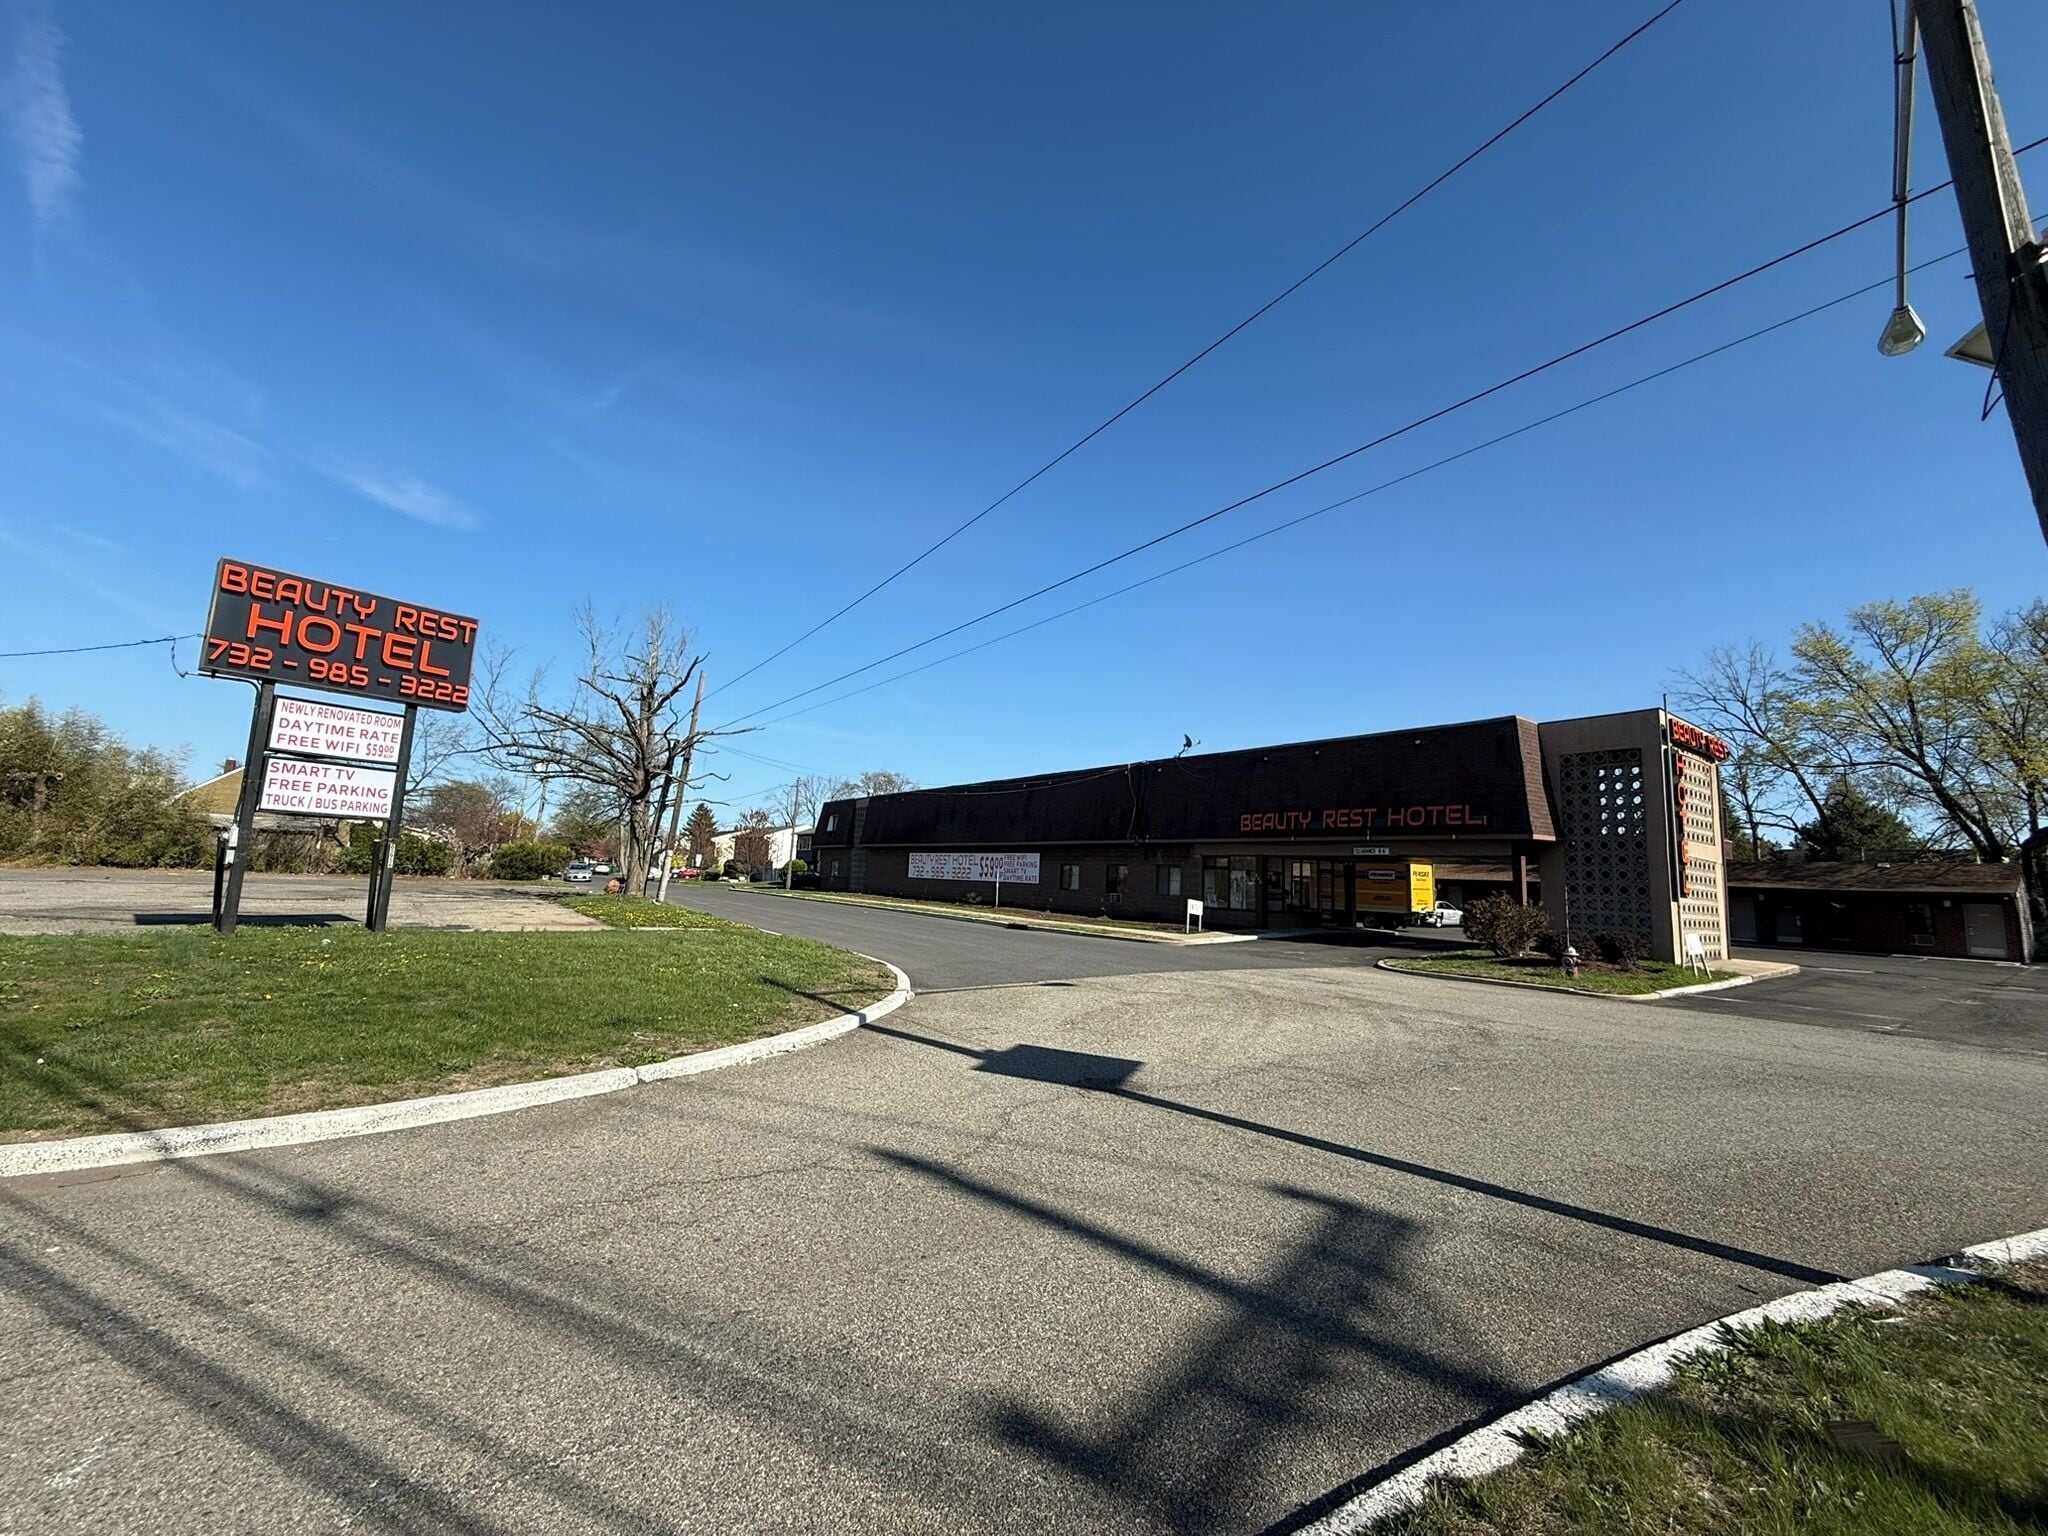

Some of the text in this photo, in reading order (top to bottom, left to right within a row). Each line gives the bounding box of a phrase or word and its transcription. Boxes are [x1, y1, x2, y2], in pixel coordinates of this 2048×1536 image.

[220, 563, 478, 644] BEAUTY REST
[247, 603, 450, 677] HOTEL
[208, 638, 274, 670] 732
[309, 657, 369, 687] 985
[399, 674, 469, 704] 3222
[281, 701, 401, 729] NEWLY RENOVATED ROOM
[276, 733, 321, 749] FREE
[325, 739, 360, 754] WIFI
[279, 717, 400, 744] DAYTIME RATE
[1672, 719, 1706, 752] BEAUTY
[269, 762, 356, 781] SMART TV
[268, 778, 388, 799] FREE PARKING
[266, 793, 305, 808] TRUCK
[315, 797, 338, 810] BUS
[340, 799, 388, 814] PARKING
[1240, 805, 1483, 831] BEAUTY REST HOTEL
[1675, 752, 1691, 895] HOTEL
[952, 854, 978, 866] HOTEL
